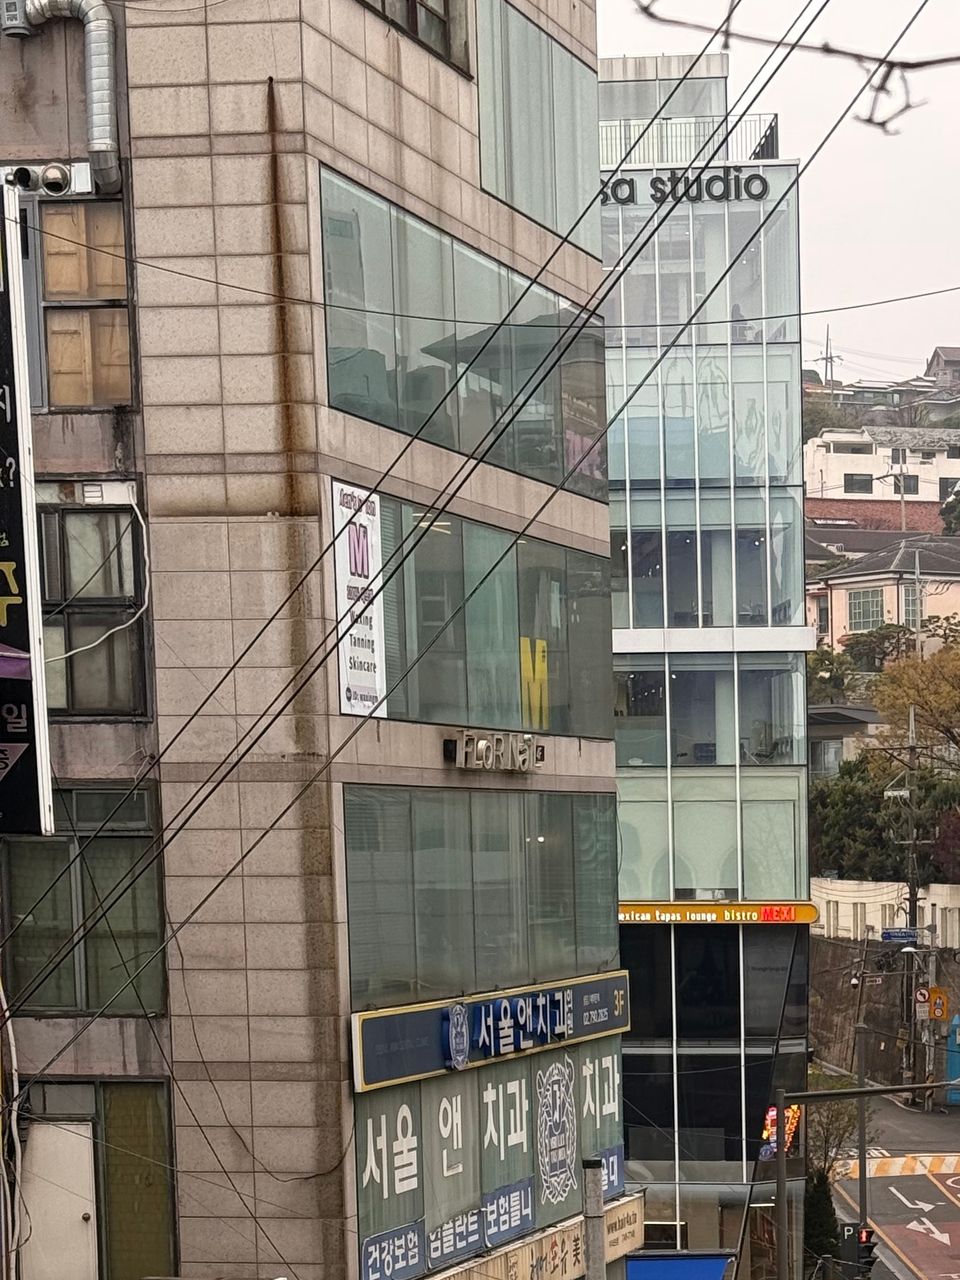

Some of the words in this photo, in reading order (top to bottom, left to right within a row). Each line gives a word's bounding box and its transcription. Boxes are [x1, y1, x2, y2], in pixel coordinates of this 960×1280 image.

[650, 164, 769, 203] studio
[348, 633, 375, 655] Tanning
[348, 655, 377, 674] Skincare
[655, 910, 681, 922] tapas
[686, 911, 718, 922] lounge
[724, 909, 758, 921] bistro
[760, 906, 796, 922] MEXI
[613, 990, 625, 1017] 3F
[478, 990, 568, 1057] 서울앤치과
[582, 1054, 620, 1129] 치과
[362, 1102, 418, 1200] 서울
[438, 1094, 464, 1178] 앤
[483, 1078, 529, 1161] 치과
[486, 1186, 533, 1237] 보험틀니
[844, 1227, 854, 1240] P
